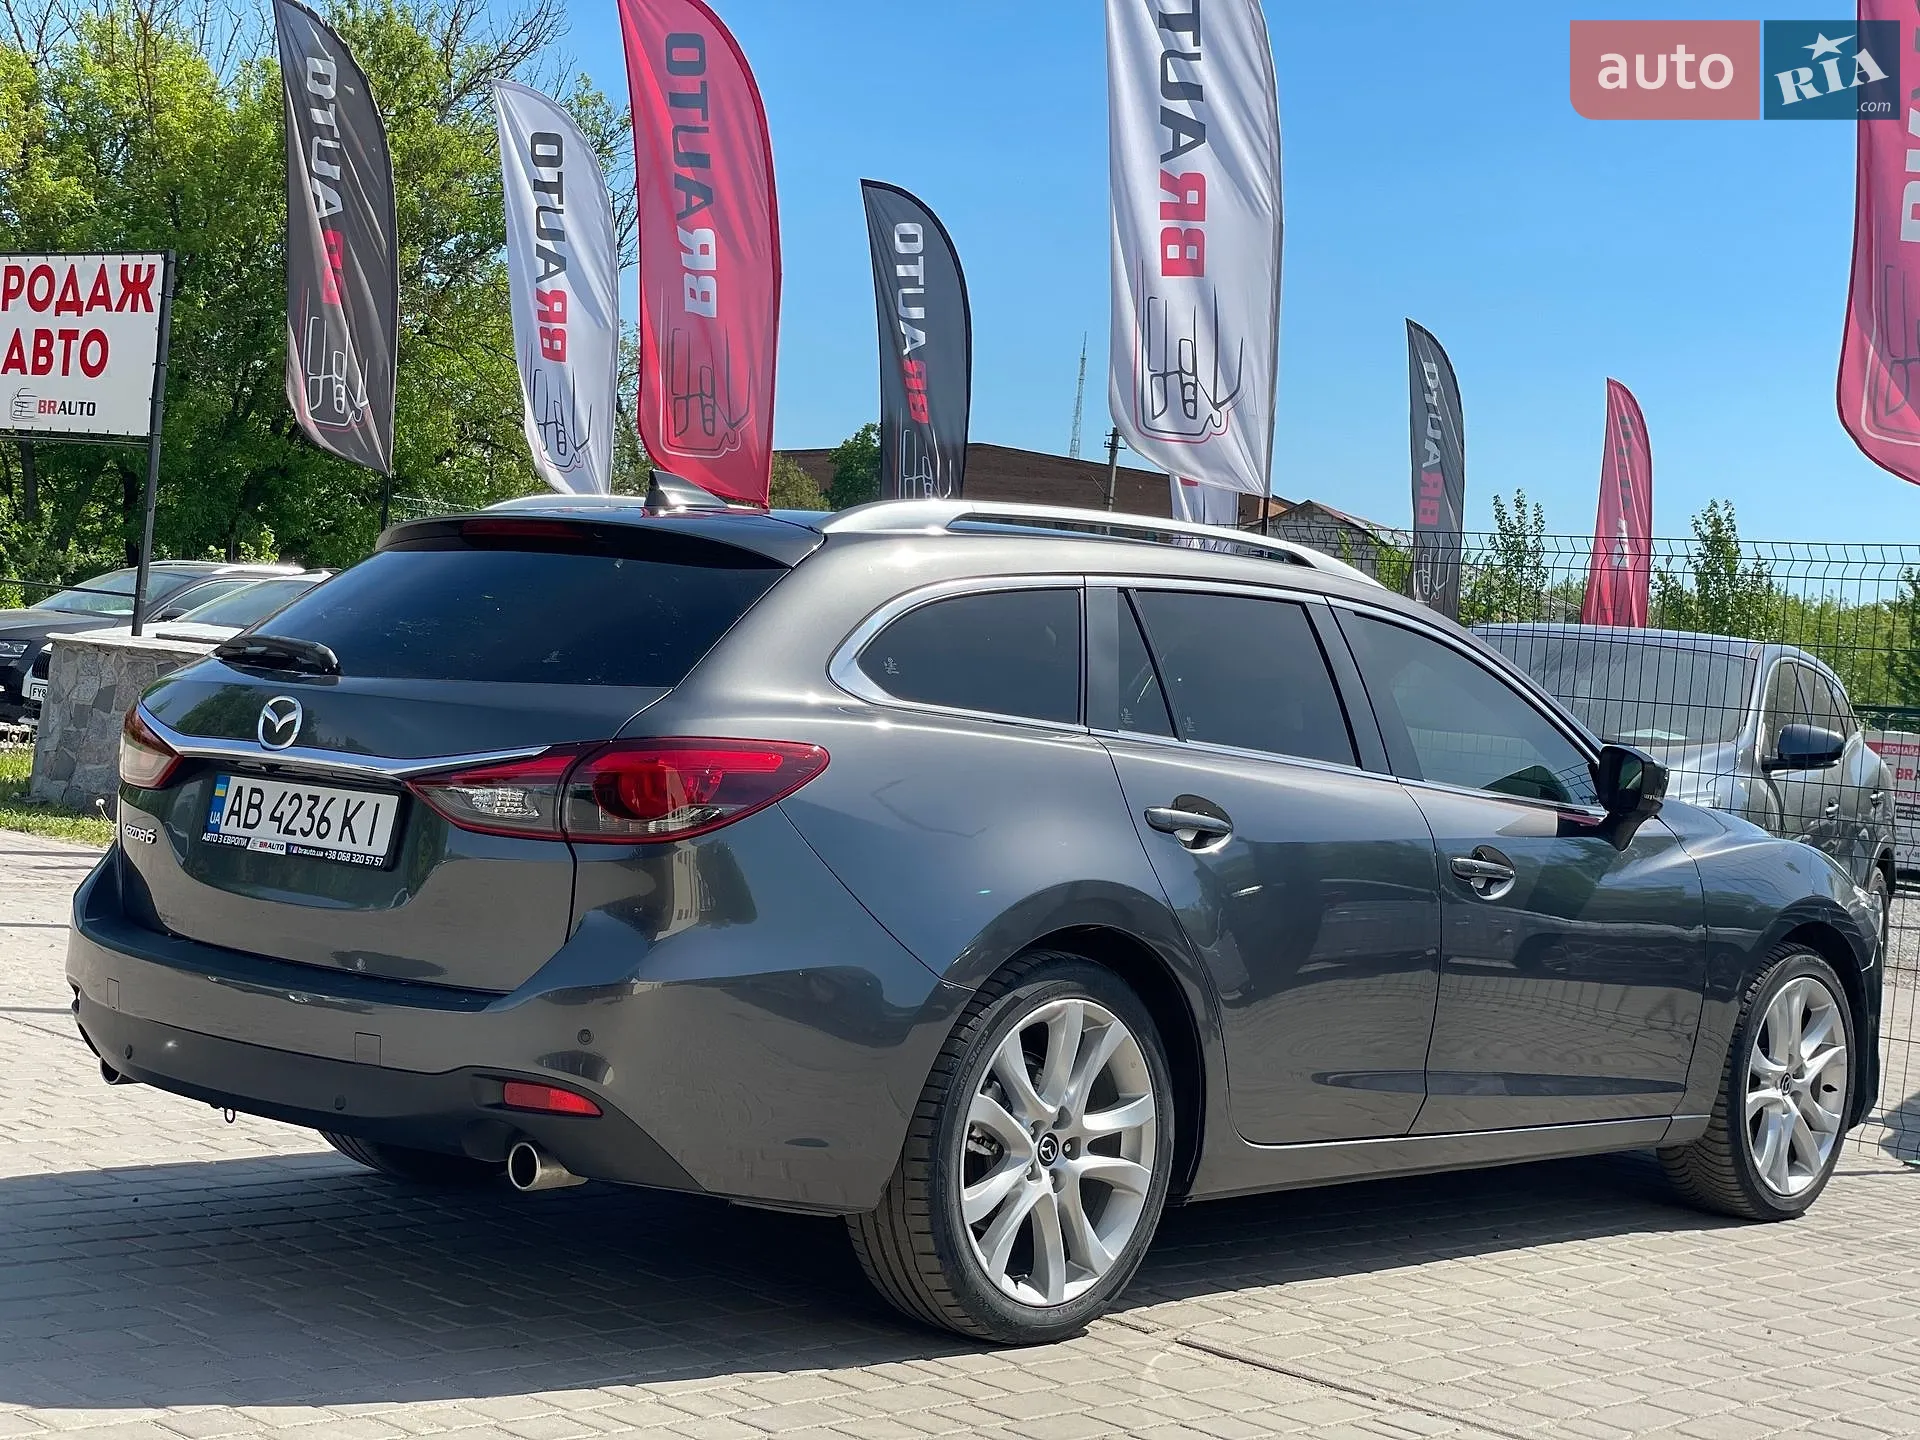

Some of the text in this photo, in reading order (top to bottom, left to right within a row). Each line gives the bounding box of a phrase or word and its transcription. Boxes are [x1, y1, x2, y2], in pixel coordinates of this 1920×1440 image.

[0, 263, 156, 317] РОДАЖ
[0, 327, 110, 379] АВТО
[38, 399, 97, 417] BRAUTO
[32, 687, 47, 698] FY8
[209, 810, 221, 825] UA
[224, 785, 264, 830] AB
[268, 790, 336, 840] 4236
[202, 832, 217, 843] АВТО
[259, 840, 285, 851] BRAUTO
[324, 850, 336, 860] +38
[337, 851, 351, 862] 068
[351, 854, 364, 864] 320
[365, 856, 374, 866] 57
[375, 857, 383, 867] 57
